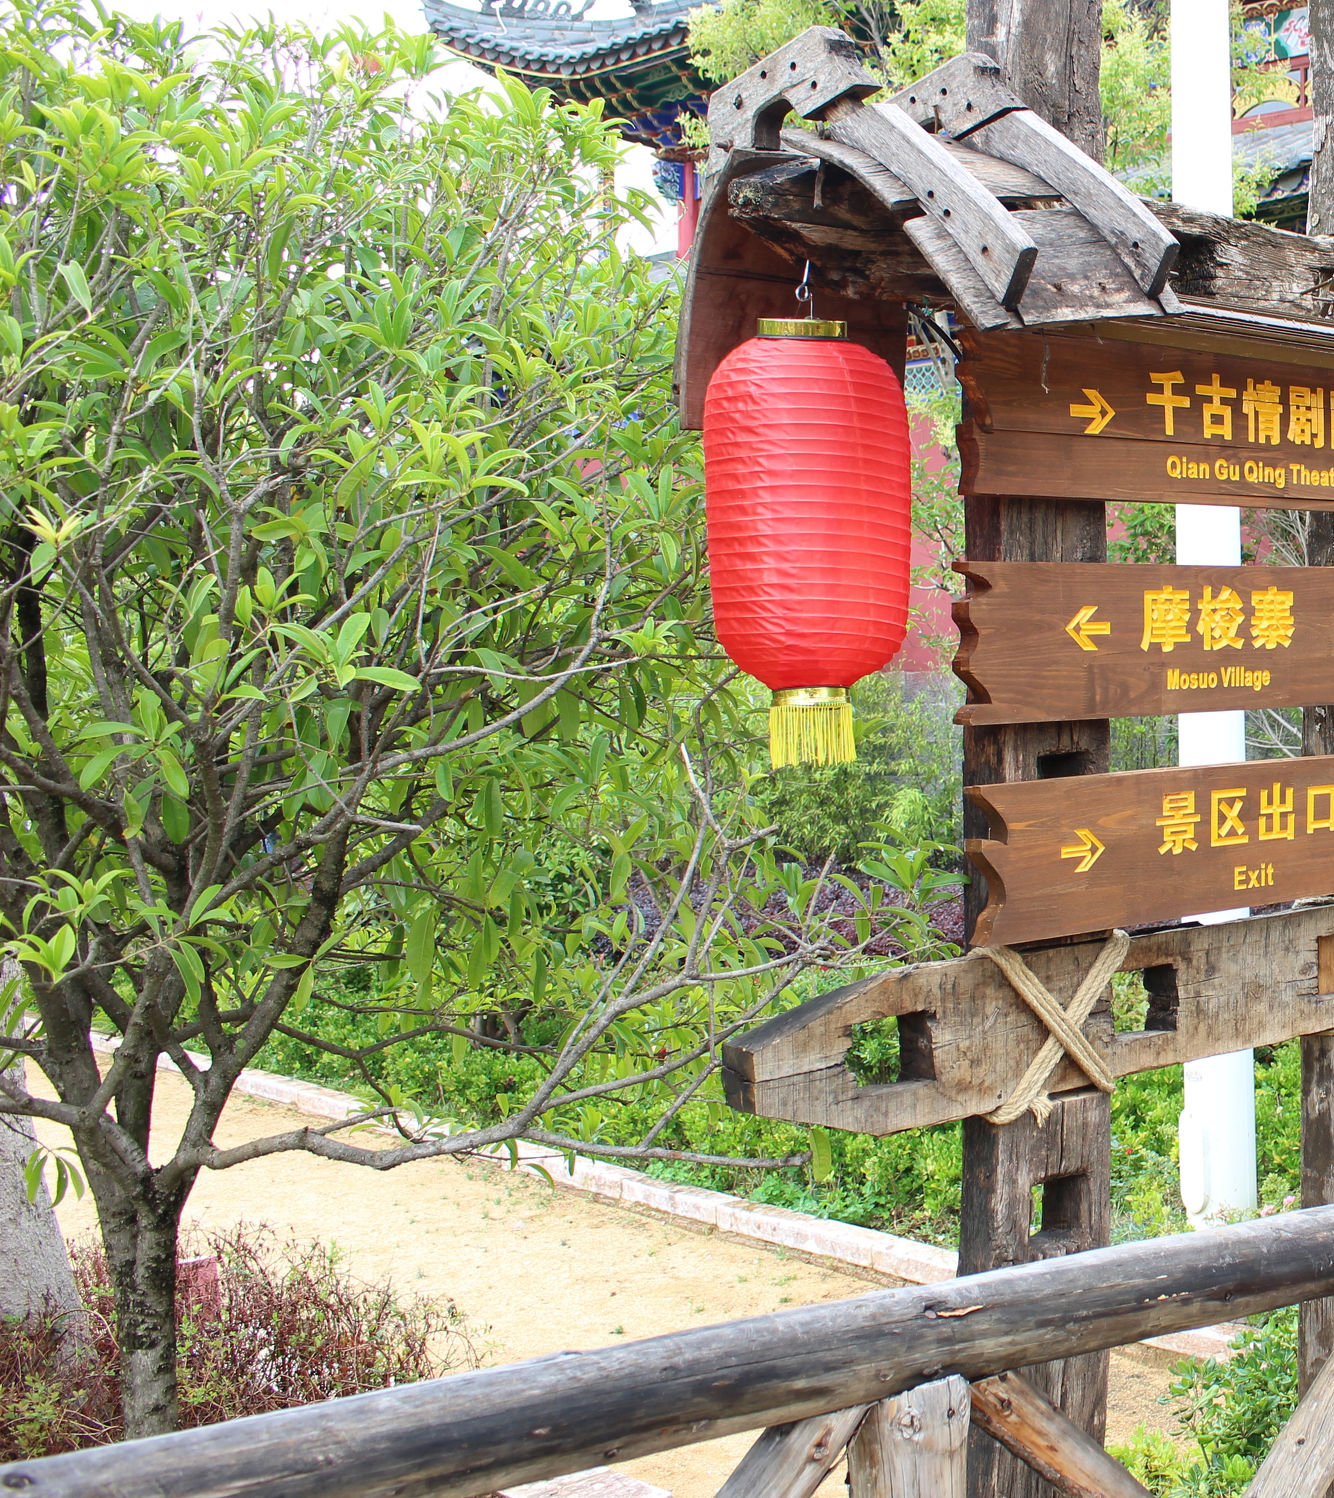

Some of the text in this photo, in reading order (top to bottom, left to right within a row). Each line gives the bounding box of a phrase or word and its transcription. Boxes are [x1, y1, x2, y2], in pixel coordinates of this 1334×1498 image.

[1166, 455, 1210, 480] Qian
[1214, 457, 1240, 482] Gu
[1243, 459, 1286, 489] Qing
[1139, 584, 1297, 653] 摩梭寨
[1166, 665, 1272, 692] Mosuo Village
[1233, 861, 1275, 891] Exit
